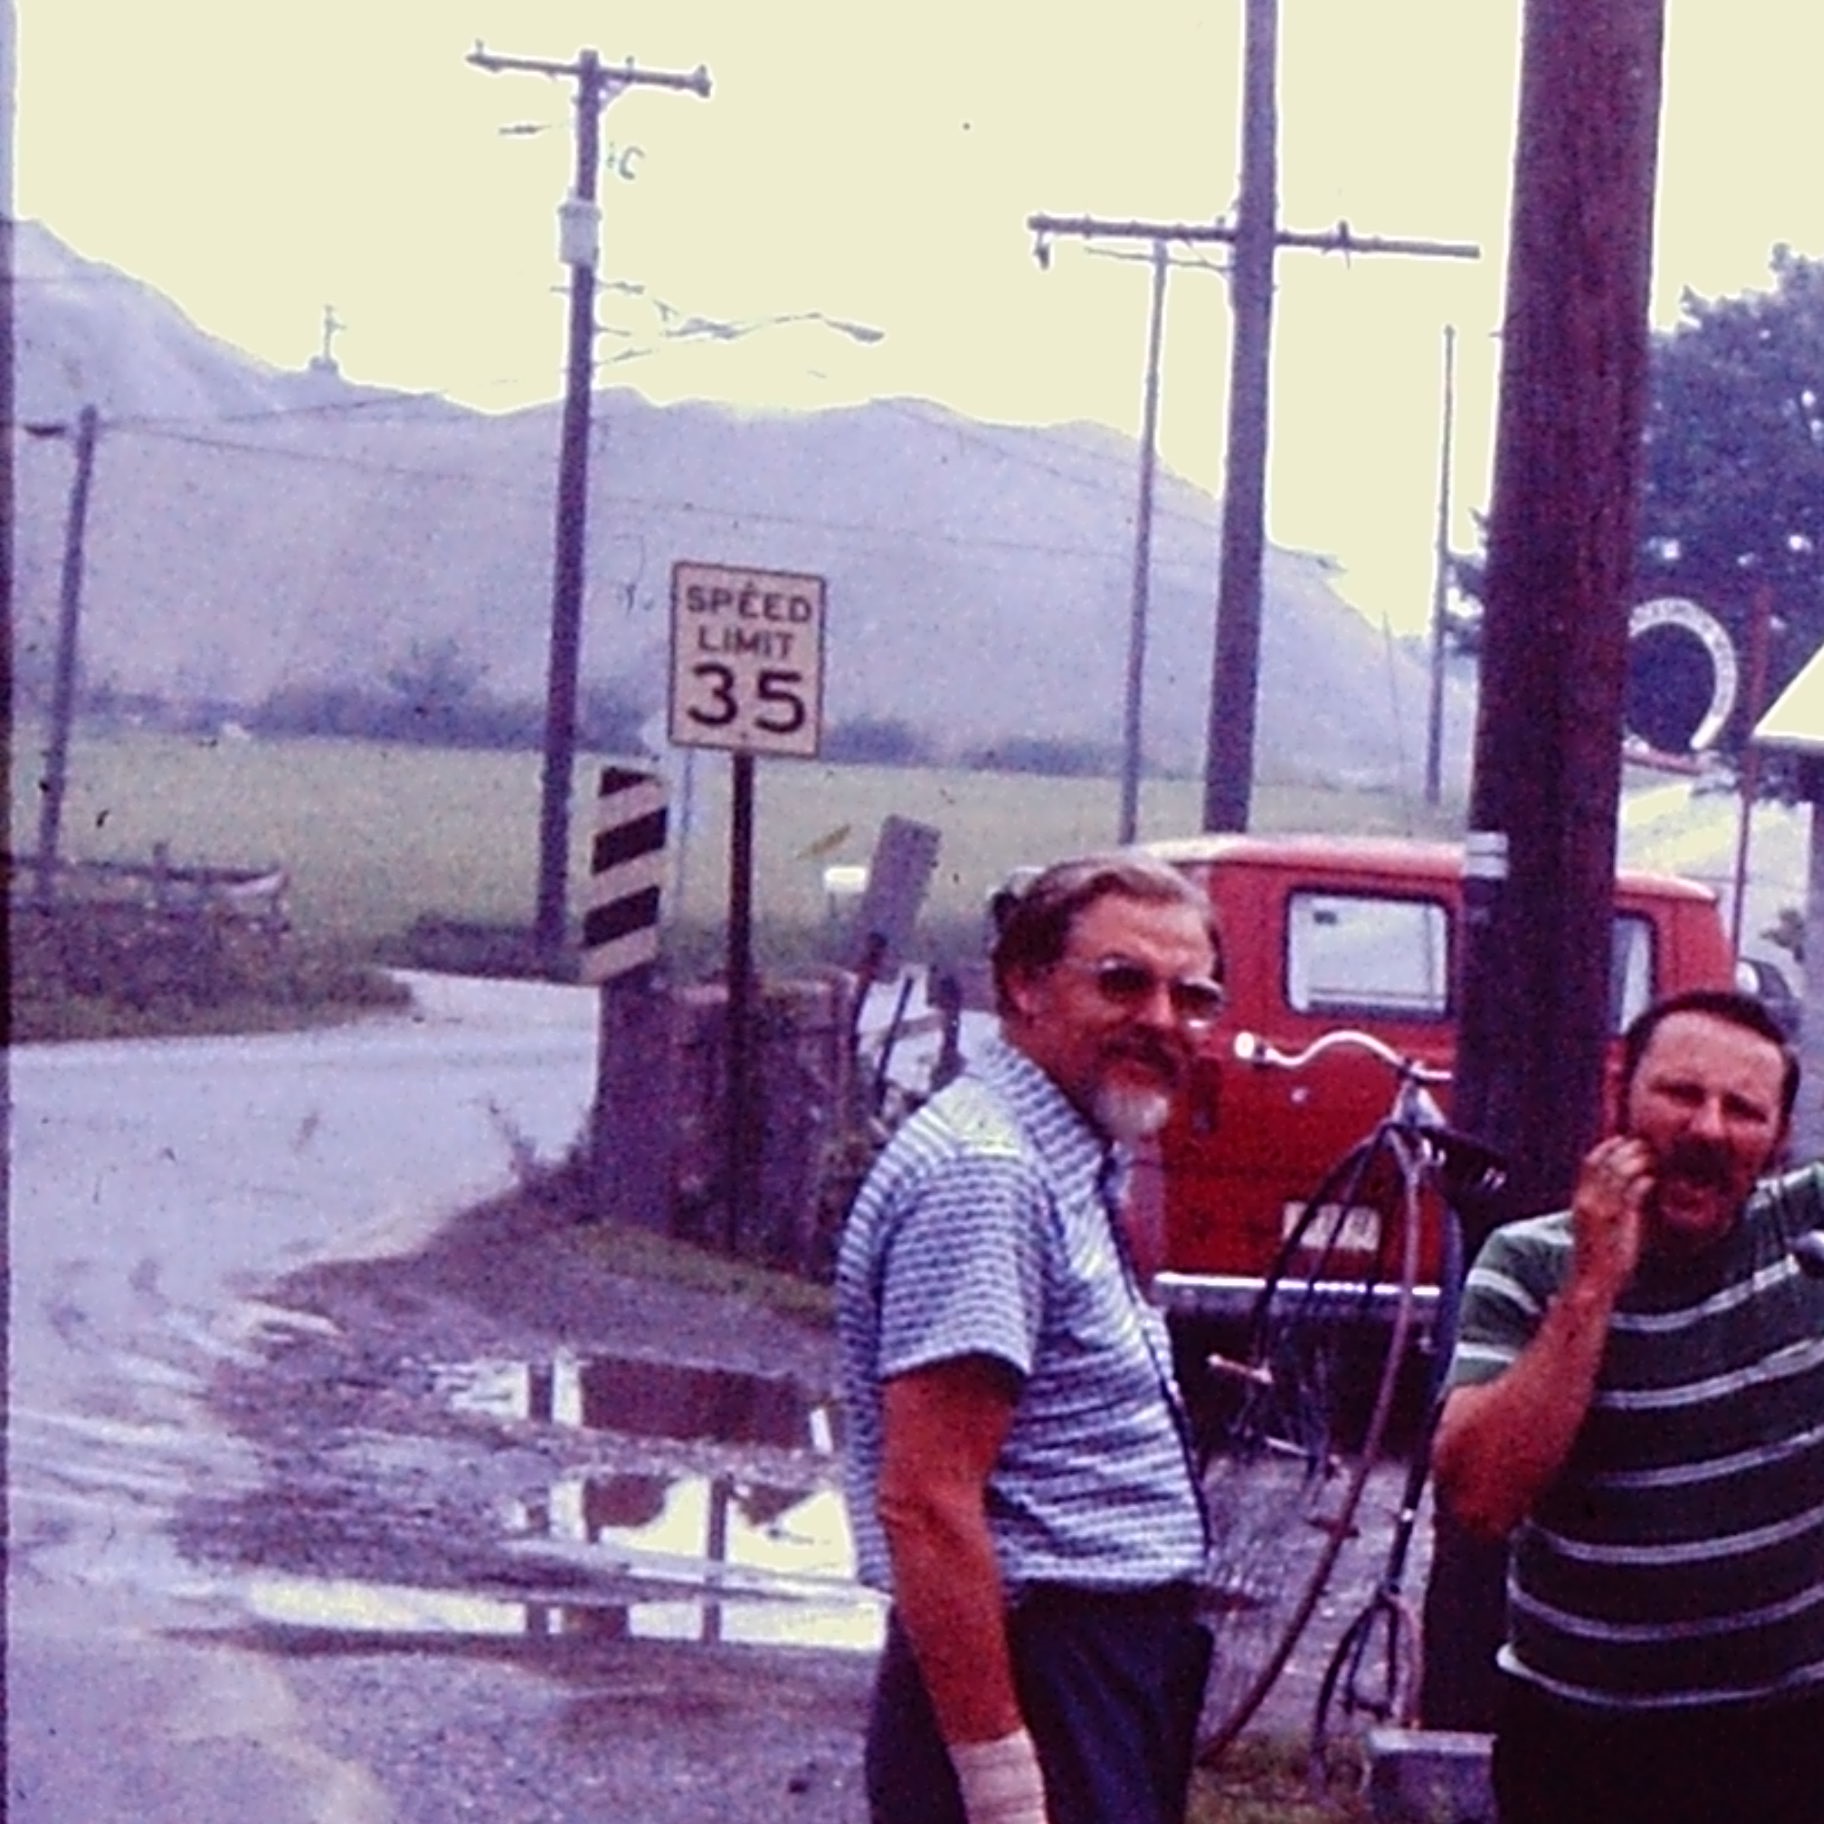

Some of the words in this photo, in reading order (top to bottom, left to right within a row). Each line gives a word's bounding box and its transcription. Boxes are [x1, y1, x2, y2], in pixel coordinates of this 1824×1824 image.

[686, 583, 812, 623] SPEED
[697, 625, 795, 658] LIMIT
[686, 661, 807, 734] 35
